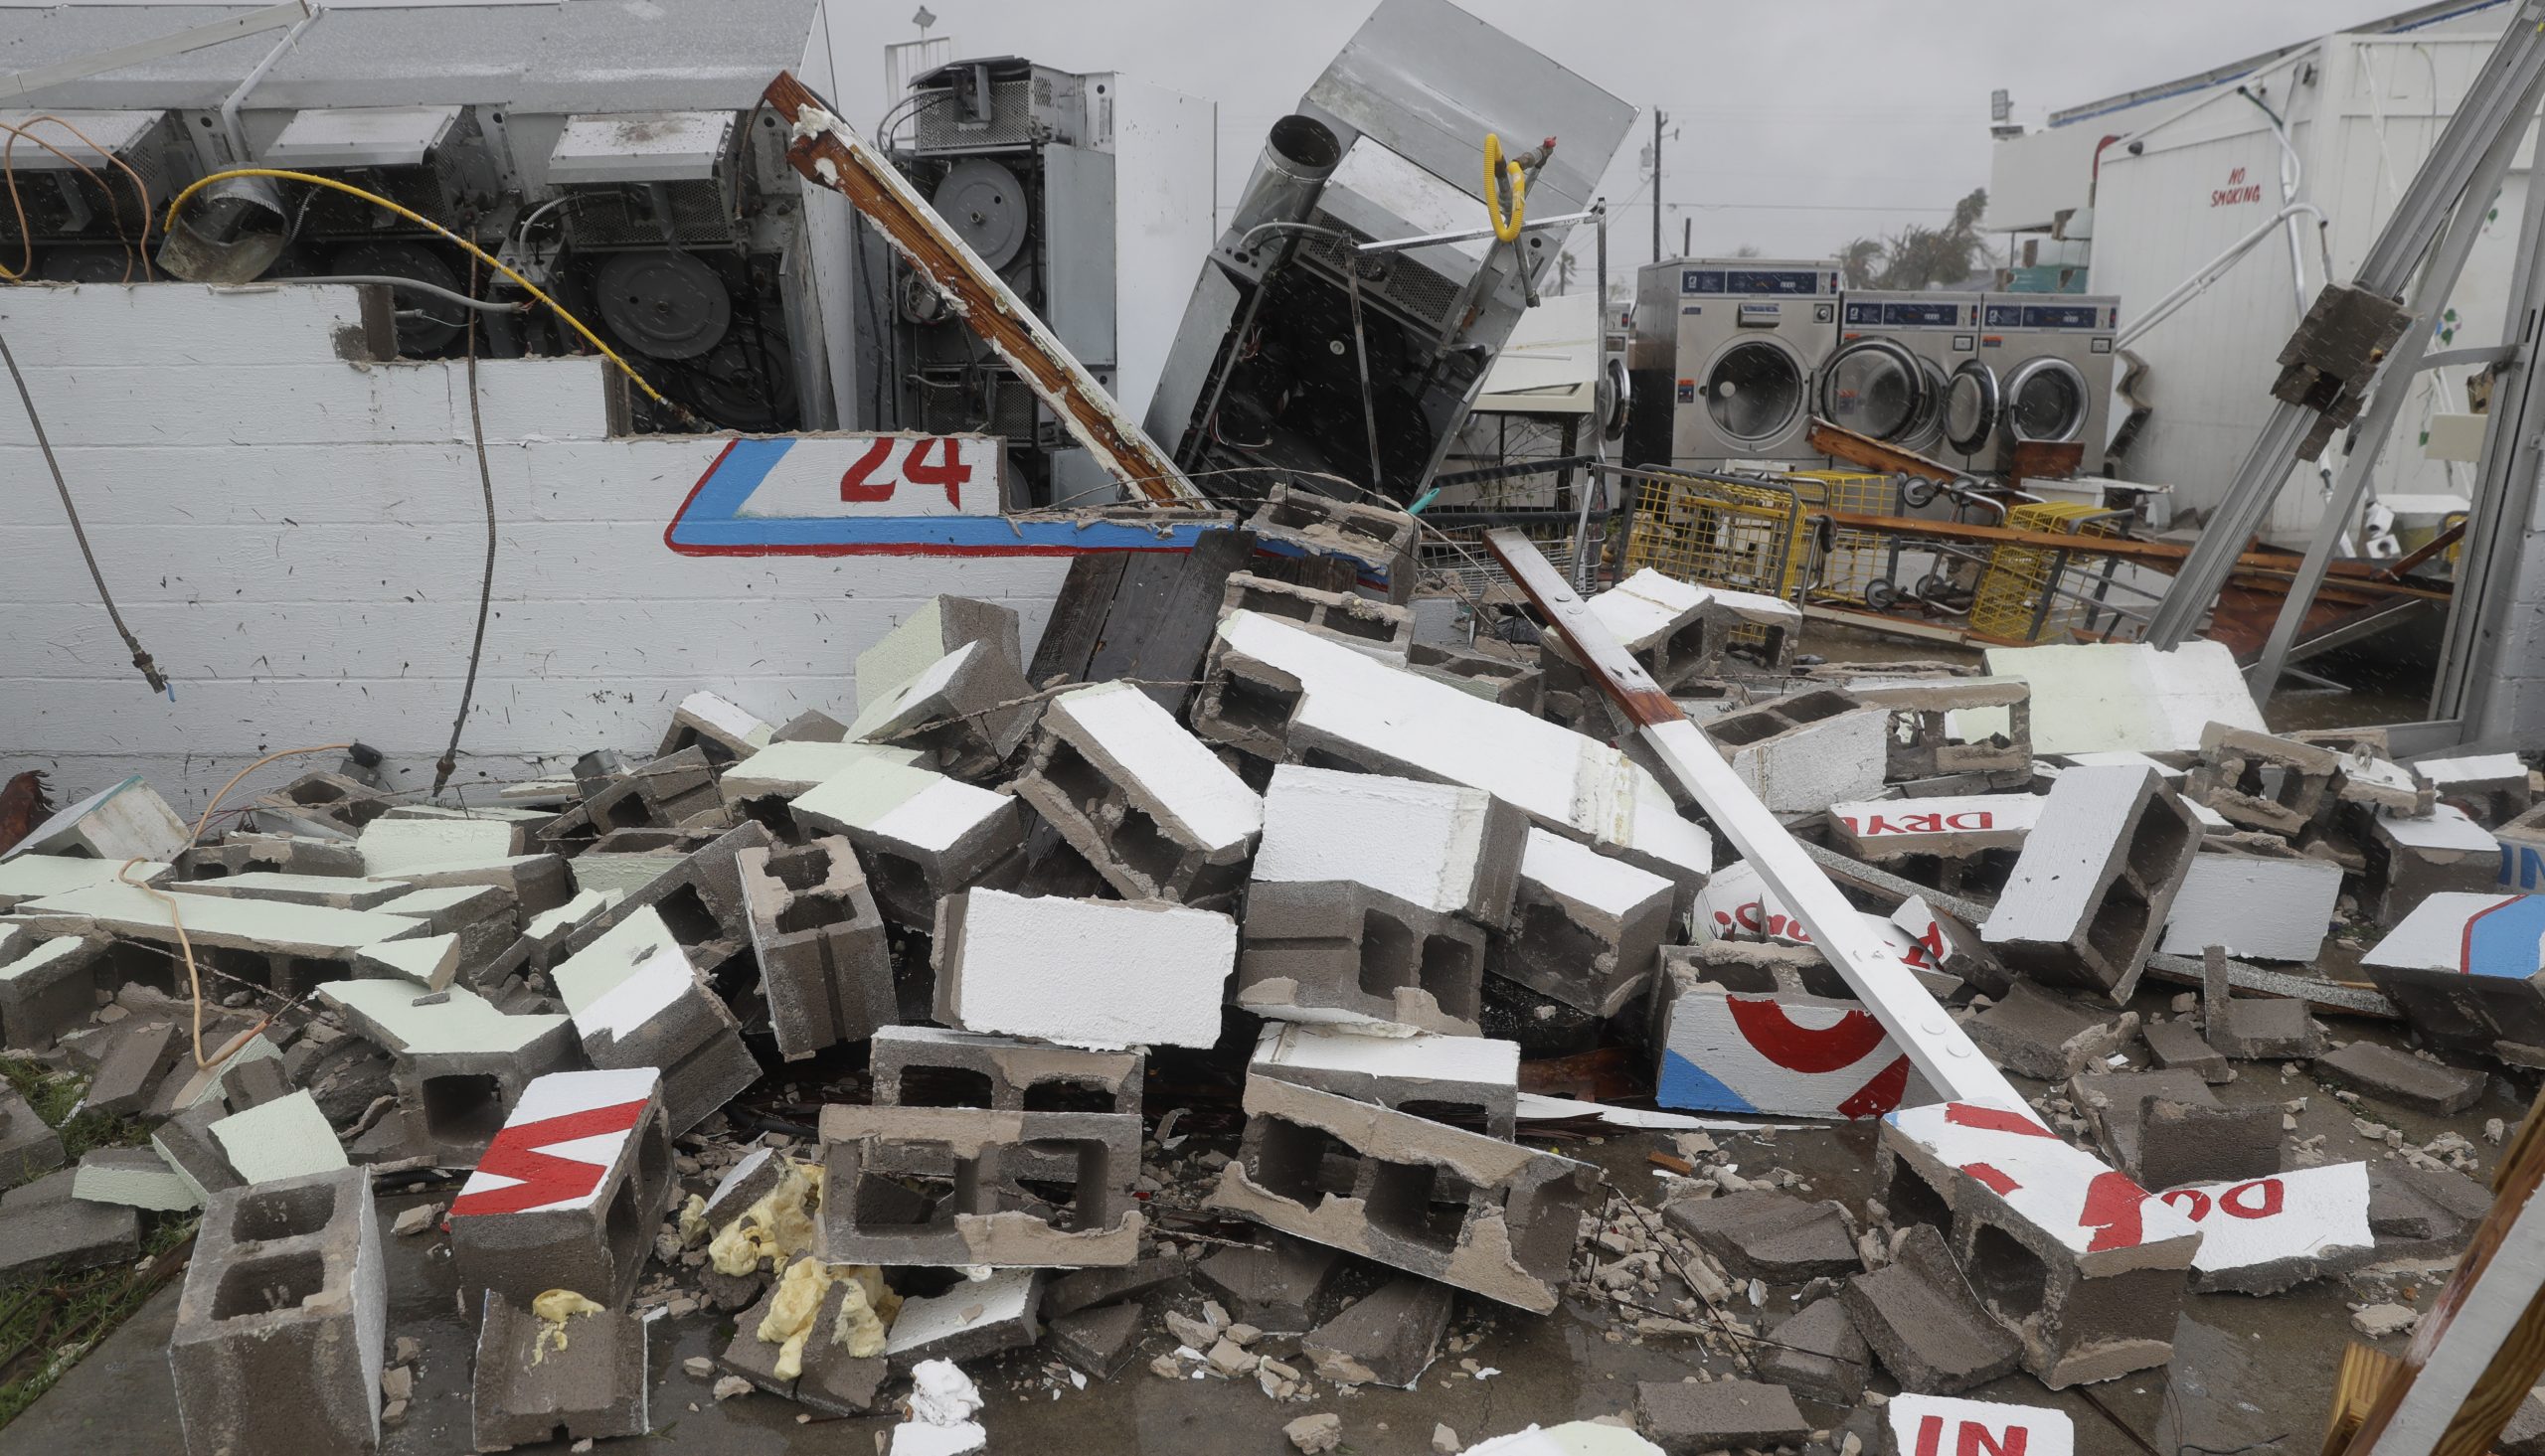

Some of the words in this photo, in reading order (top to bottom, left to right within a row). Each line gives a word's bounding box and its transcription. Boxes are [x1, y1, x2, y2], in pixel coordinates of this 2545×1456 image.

[2228, 167, 2246, 186] NO
[2210, 185, 2261, 208] SMOKING
[840, 437, 972, 512] 24
